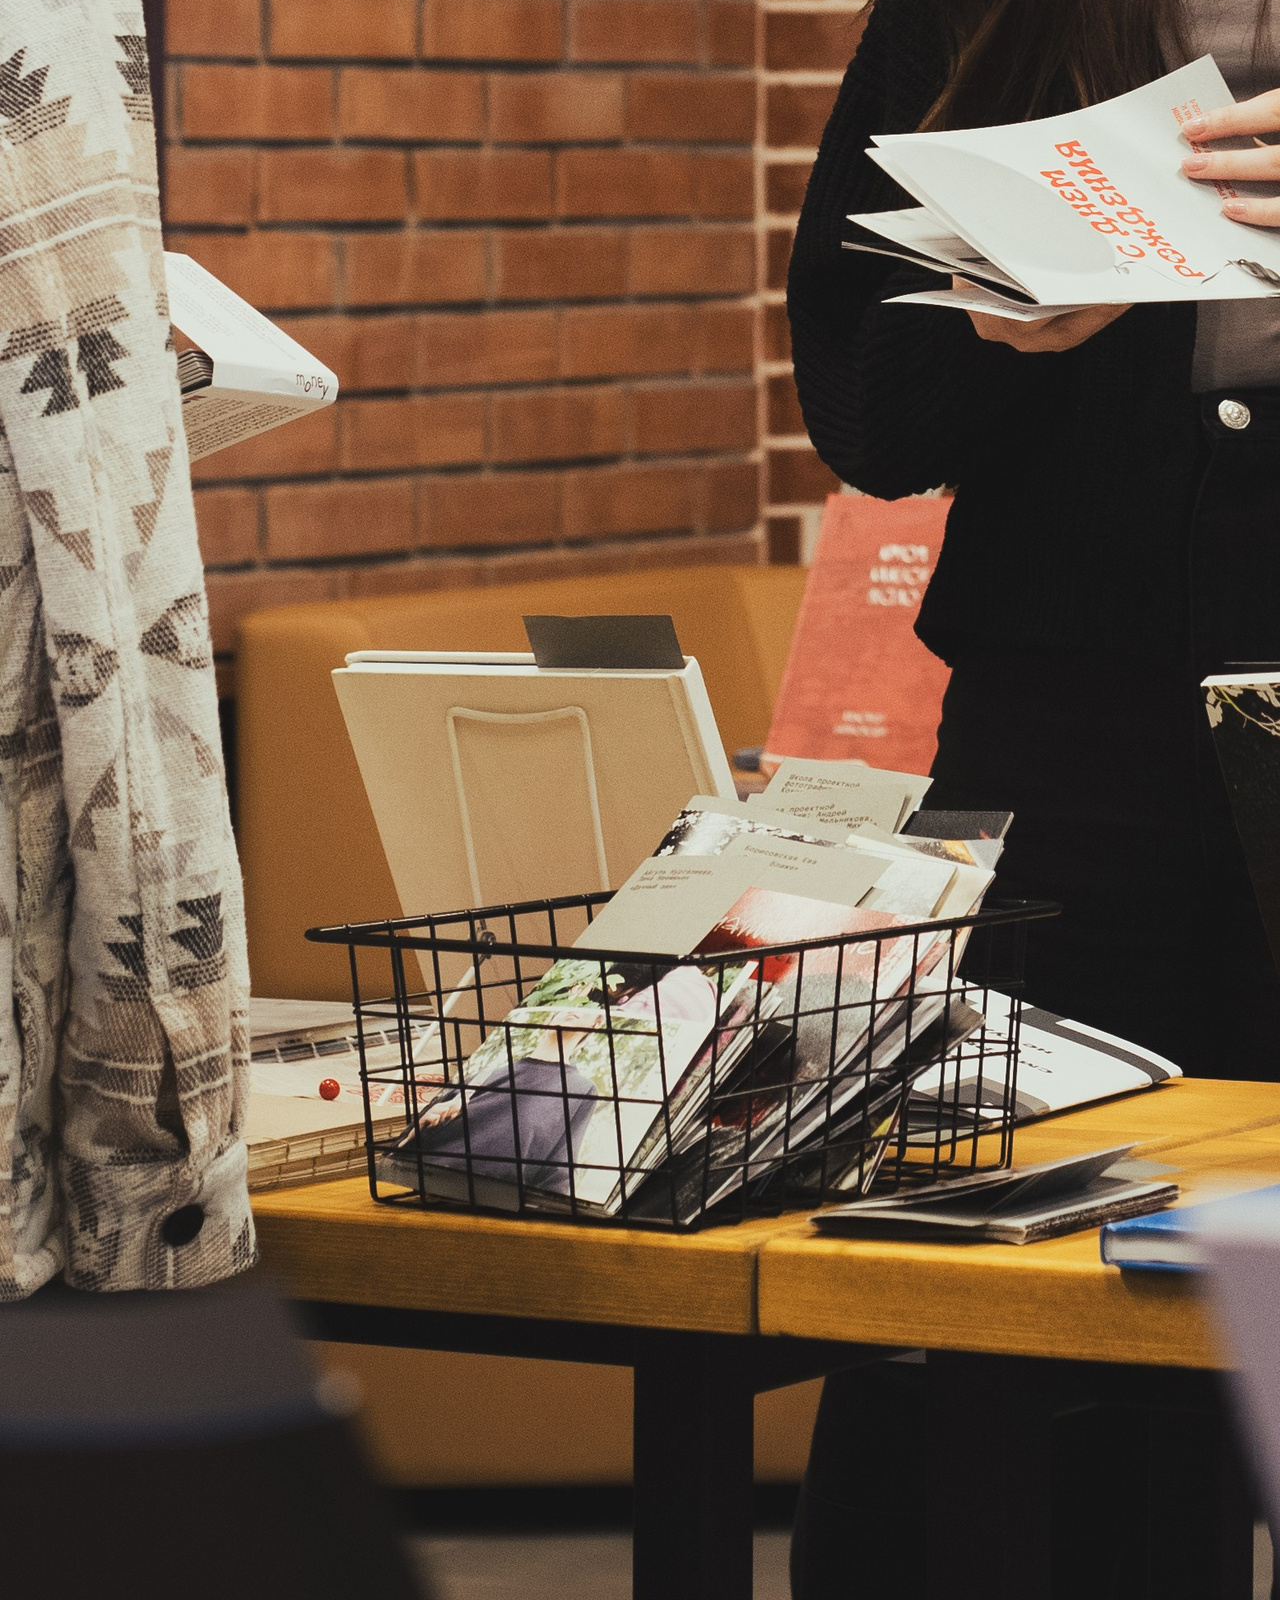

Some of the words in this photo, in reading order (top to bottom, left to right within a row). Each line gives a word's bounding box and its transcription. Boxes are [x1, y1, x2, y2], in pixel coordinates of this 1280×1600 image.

[1054, 140, 1205, 278] РОЖДЕНИЯ
[1116, 243, 1146, 260] С
[296, 373, 329, 400] money
[789, 774, 813, 782] Школа
[816, 778, 861, 788] проектной
[789, 803, 835, 813] проектной
[816, 809, 847, 818] Андрей
[744, 845, 798, 861] Борисовская
[801, 856, 818, 865] Ева
